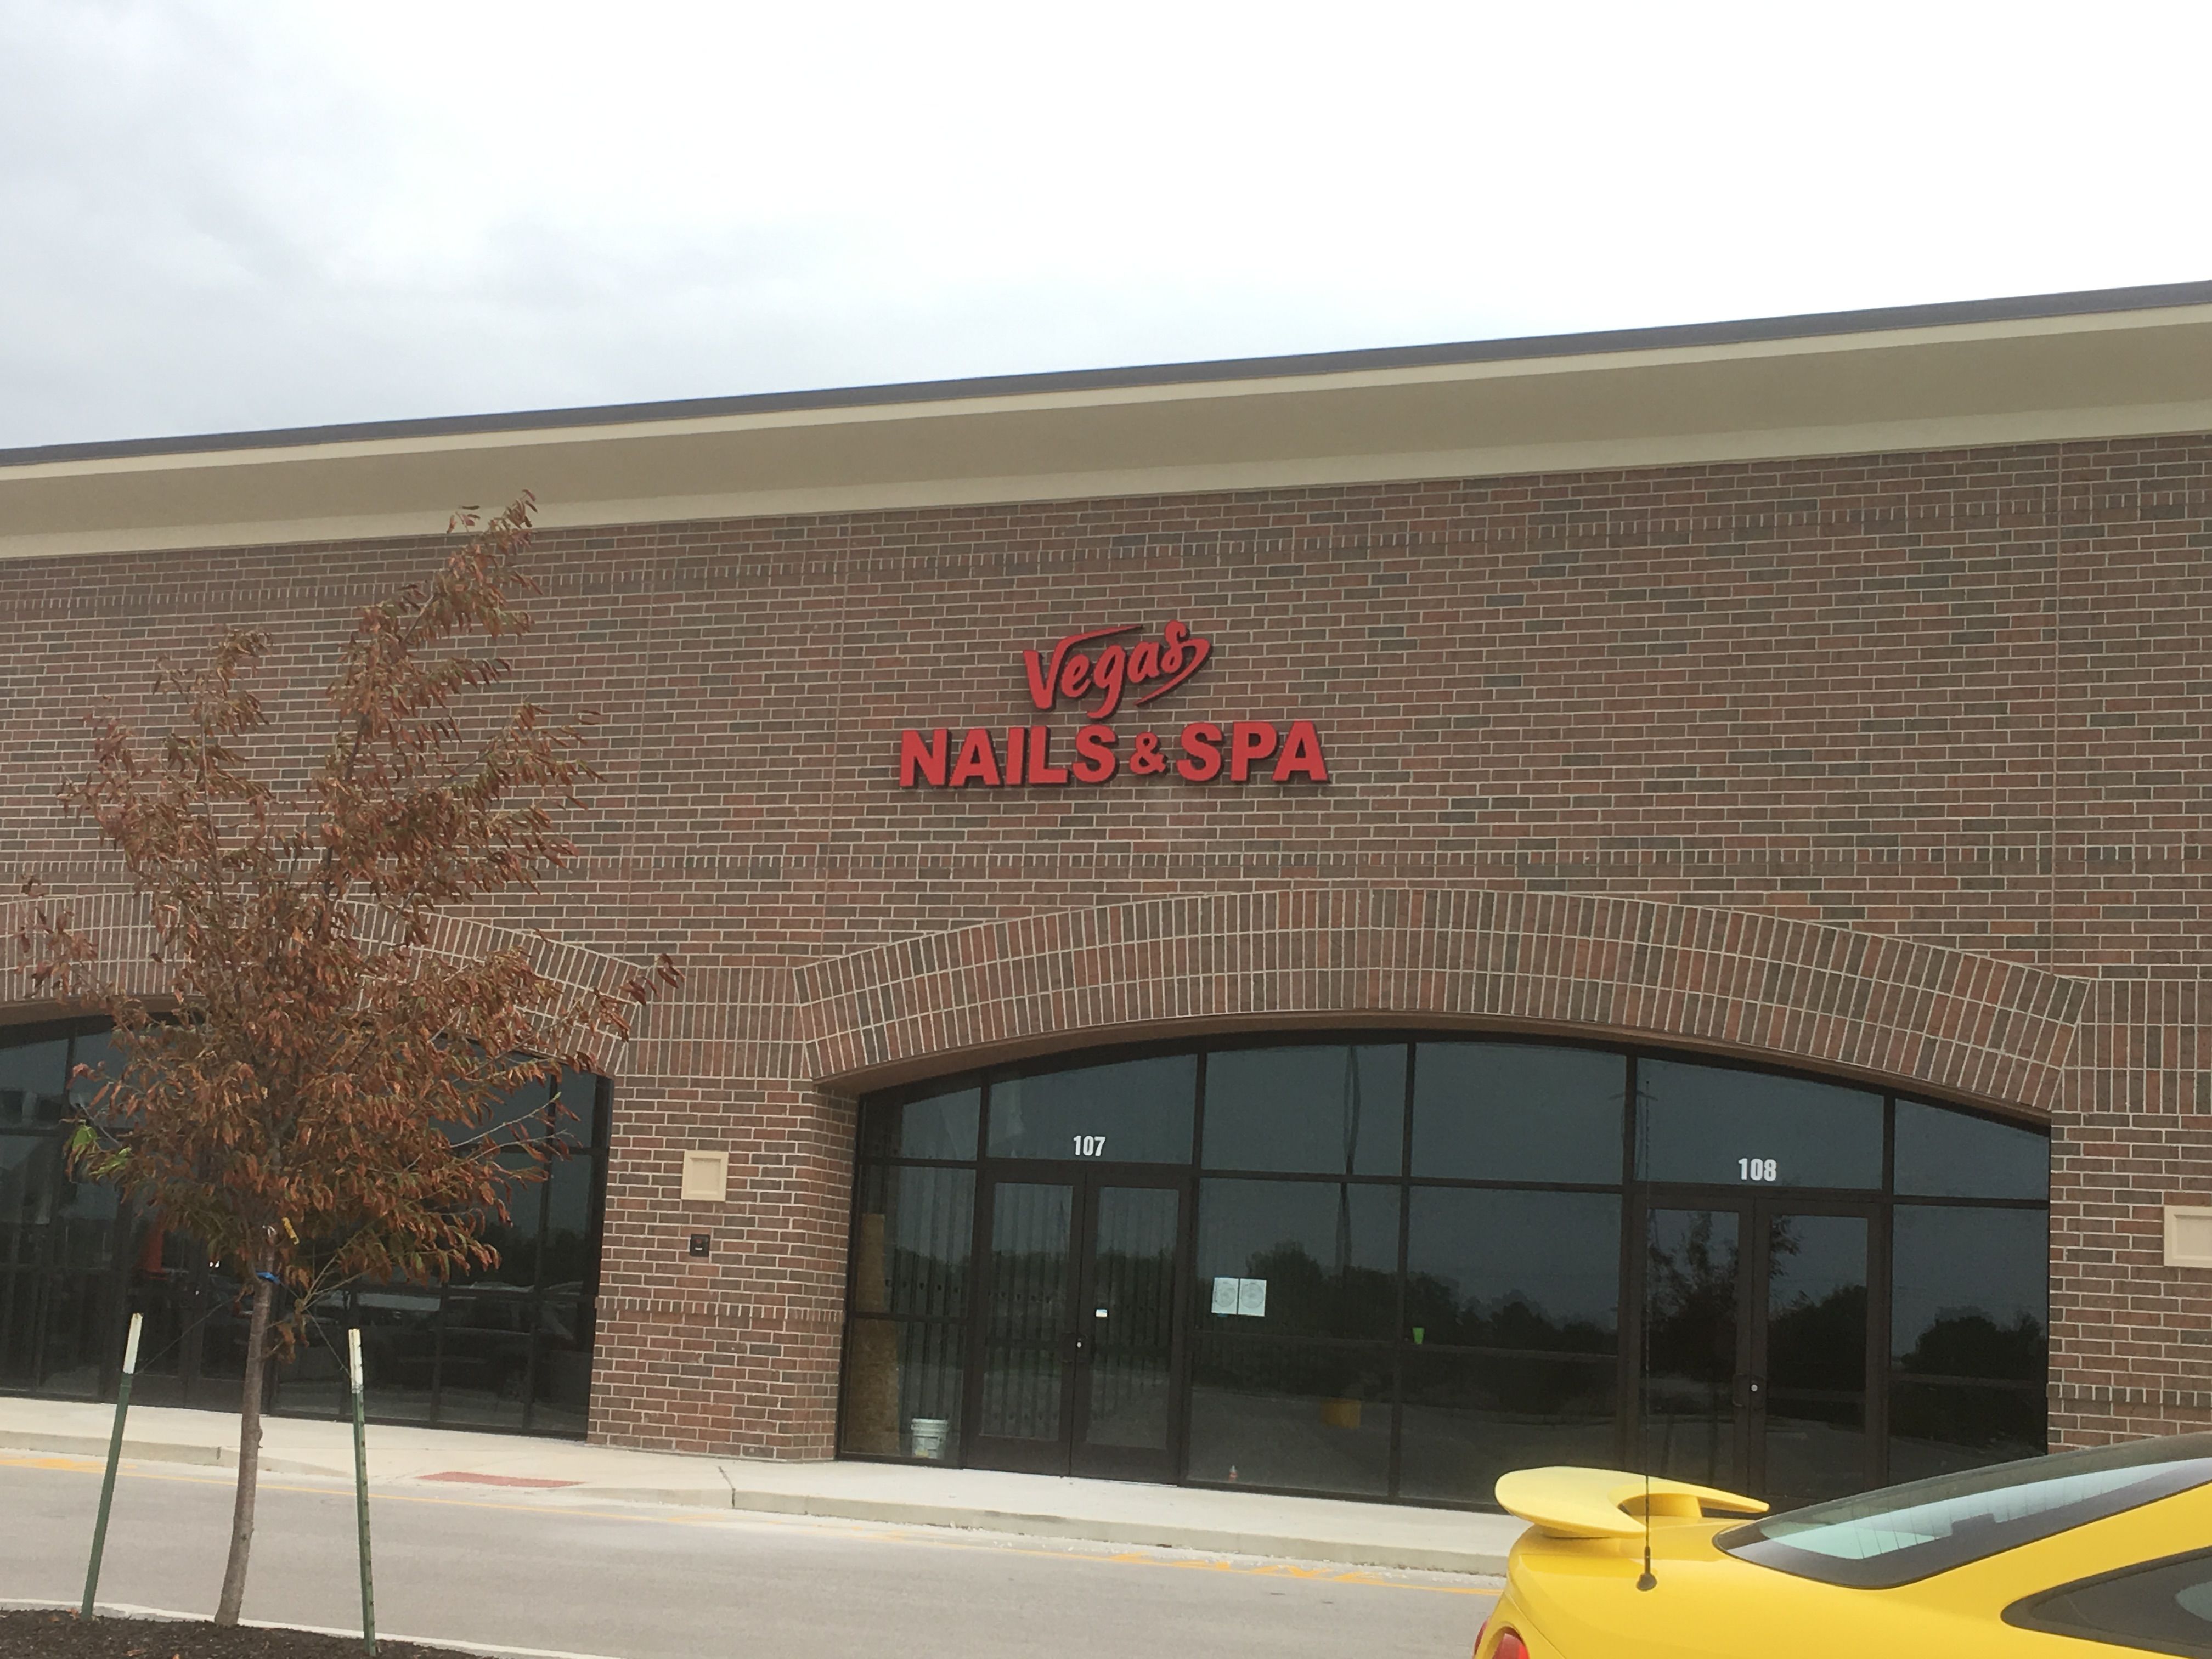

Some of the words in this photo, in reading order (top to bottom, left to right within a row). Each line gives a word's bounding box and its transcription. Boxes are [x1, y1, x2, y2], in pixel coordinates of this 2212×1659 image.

[1023, 620, 1209, 718] Vegas
[899, 724, 1115, 786] NAILS
[1129, 732, 1166, 775] &
[1176, 720, 1328, 782] SPA
[1073, 1135, 1106, 1156] 107
[1737, 1158, 1778, 1181] 108
